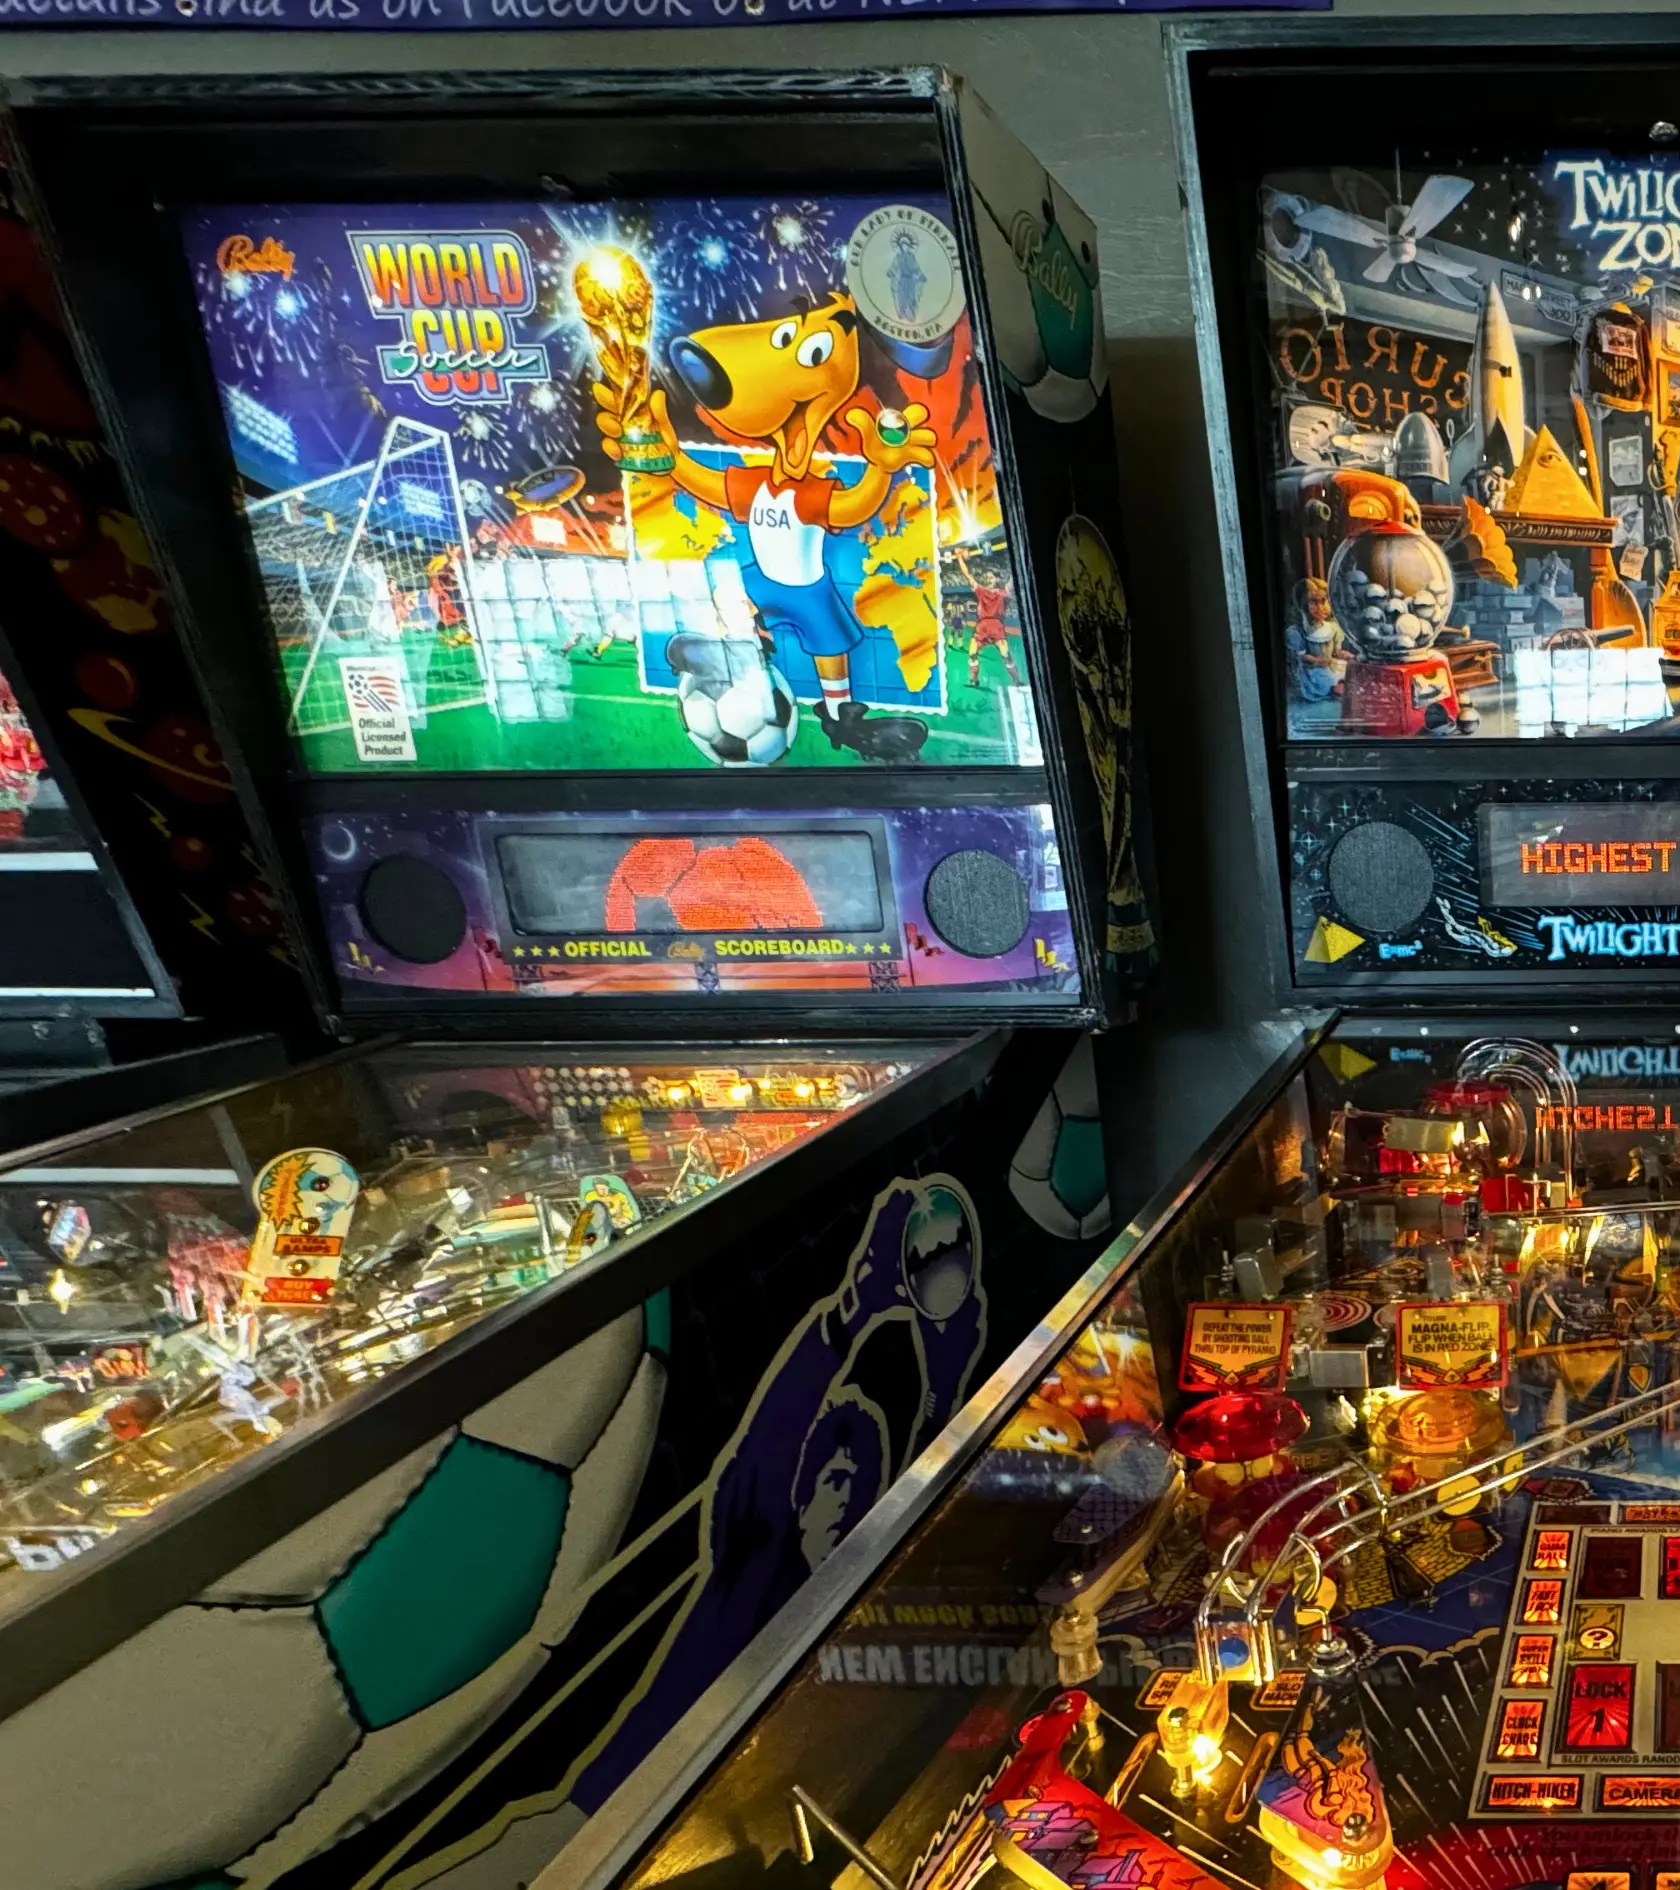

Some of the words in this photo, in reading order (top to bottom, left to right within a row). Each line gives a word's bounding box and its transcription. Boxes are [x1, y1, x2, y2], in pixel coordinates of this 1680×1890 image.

[216, 234, 297, 280] Bally
[363, 243, 524, 308] WORLD
[1010, 210, 1078, 331] Bally
[411, 309, 505, 393] CUP
[395, 340, 538, 378] Soccer
[753, 506, 792, 531] USA
[359, 718, 395, 729] Official
[362, 731, 406, 742] Licensed
[364, 745, 403, 756] Product
[1520, 842, 1677, 874] HIGHEST
[564, 941, 651, 957] OFFICIAL
[715, 939, 844, 957] SCOREBOARD
[1203, 1322, 1229, 1332] DEFEAT
[1230, 1323, 1245, 1333] THE
[1245, 1324, 1272, 1333] POWER
[1202, 1333, 1211, 1343] BY
[1213, 1334, 1251, 1343] SHOOTING
[1408, 1334, 1432, 1344] FLIP
[1433, 1333, 1466, 1342] WHEN
[1468, 1331, 1496, 1342] BALL
[1195, 1344, 1214, 1353] THRU
[1216, 1344, 1230, 1354] TOP
[1230, 1345, 1240, 1354] OF
[1241, 1345, 1276, 1355] PYRAMID
[1413, 1343, 1423, 1352] IS
[1424, 1343, 1435, 1352] IN
[1437, 1342, 1460, 1352] RED
[1461, 1342, 1492, 1352] ZONE
[1531, 1591, 1557, 1600] FAST
[1519, 1654, 1546, 1665] SKILL
[1275, 1683, 1300, 1691] SLO
[1574, 1681, 1627, 1699] LOCK
[1506, 1716, 1537, 1729] CLOCK
[1588, 1708, 1606, 1733] 1
[1561, 1754, 1590, 1764] SLOT
[1591, 1754, 1639, 1764] AWARDS
[1492, 1781, 1576, 1800] HITCH-HIKER
